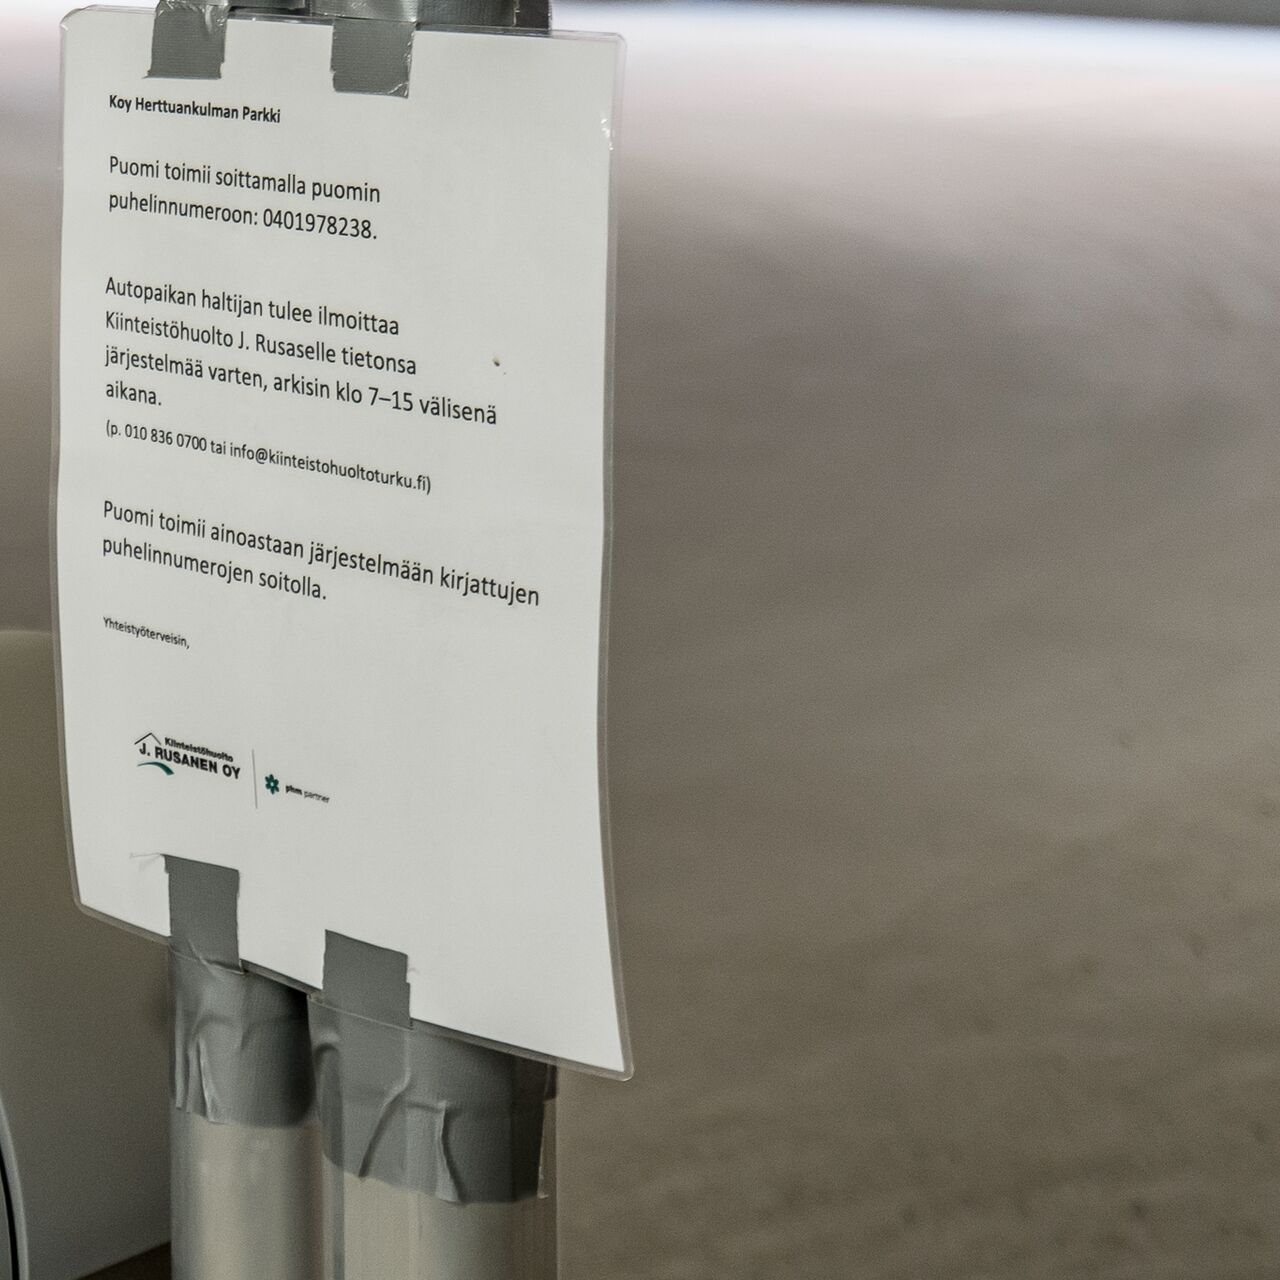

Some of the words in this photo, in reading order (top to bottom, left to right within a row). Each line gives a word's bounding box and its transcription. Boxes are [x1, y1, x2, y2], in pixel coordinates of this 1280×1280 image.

[109, 95, 132, 113] Koy
[136, 97, 239, 119] Herttuankulman
[242, 106, 280, 123] Parkki
[110, 156, 159, 178] Puomi
[164, 163, 211, 184] toimii
[216, 169, 305, 195] soittamalla
[312, 182, 380, 203] puomin
[109, 191, 258, 225] puhelinnumeroon:
[263, 208, 377, 239] 0401978238.
[105, 277, 196, 307] Autopaikan
[202, 289, 262, 318] haltijan
[268, 301, 312, 323] tulee
[319, 306, 399, 335] ilmoittaa
[106, 310, 233, 347] Kiinteistöhuolto
[238, 331, 249, 350] J.
[256, 333, 336, 363] Rusaselle
[341, 347, 416, 375] tietonsa
[104, 345, 203, 378] järjestelmää
[208, 366, 267, 392] varten,
[273, 373, 330, 399] arkisin
[336, 380, 362, 403] klo
[419, 396, 496, 425] välisenä
[106, 380, 161, 406] aikana.
[106, 419, 121, 438] (p.
[125, 424, 147, 440] 010
[151, 429, 173, 445] 836
[176, 433, 207, 451] 0700
[210, 440, 226, 455] tai
[230, 442, 431, 495] info@kiinteistohuoltoturku.fi)
[103, 537, 253, 584] puhelinnumerojen
[259, 572, 326, 600] soitolla.
[104, 500, 154, 527] Puomi
[159, 513, 205, 538] toimii
[211, 523, 303, 558] ainoastaan
[308, 541, 433, 585] järjestelmään
[440, 566, 539, 606] kirjattujen
[103, 616, 189, 649] Yhteistyöterveisin,
[139, 743, 151, 757] J.
[154, 746, 218, 774] RUSANEN
[222, 764, 241, 780] OY
